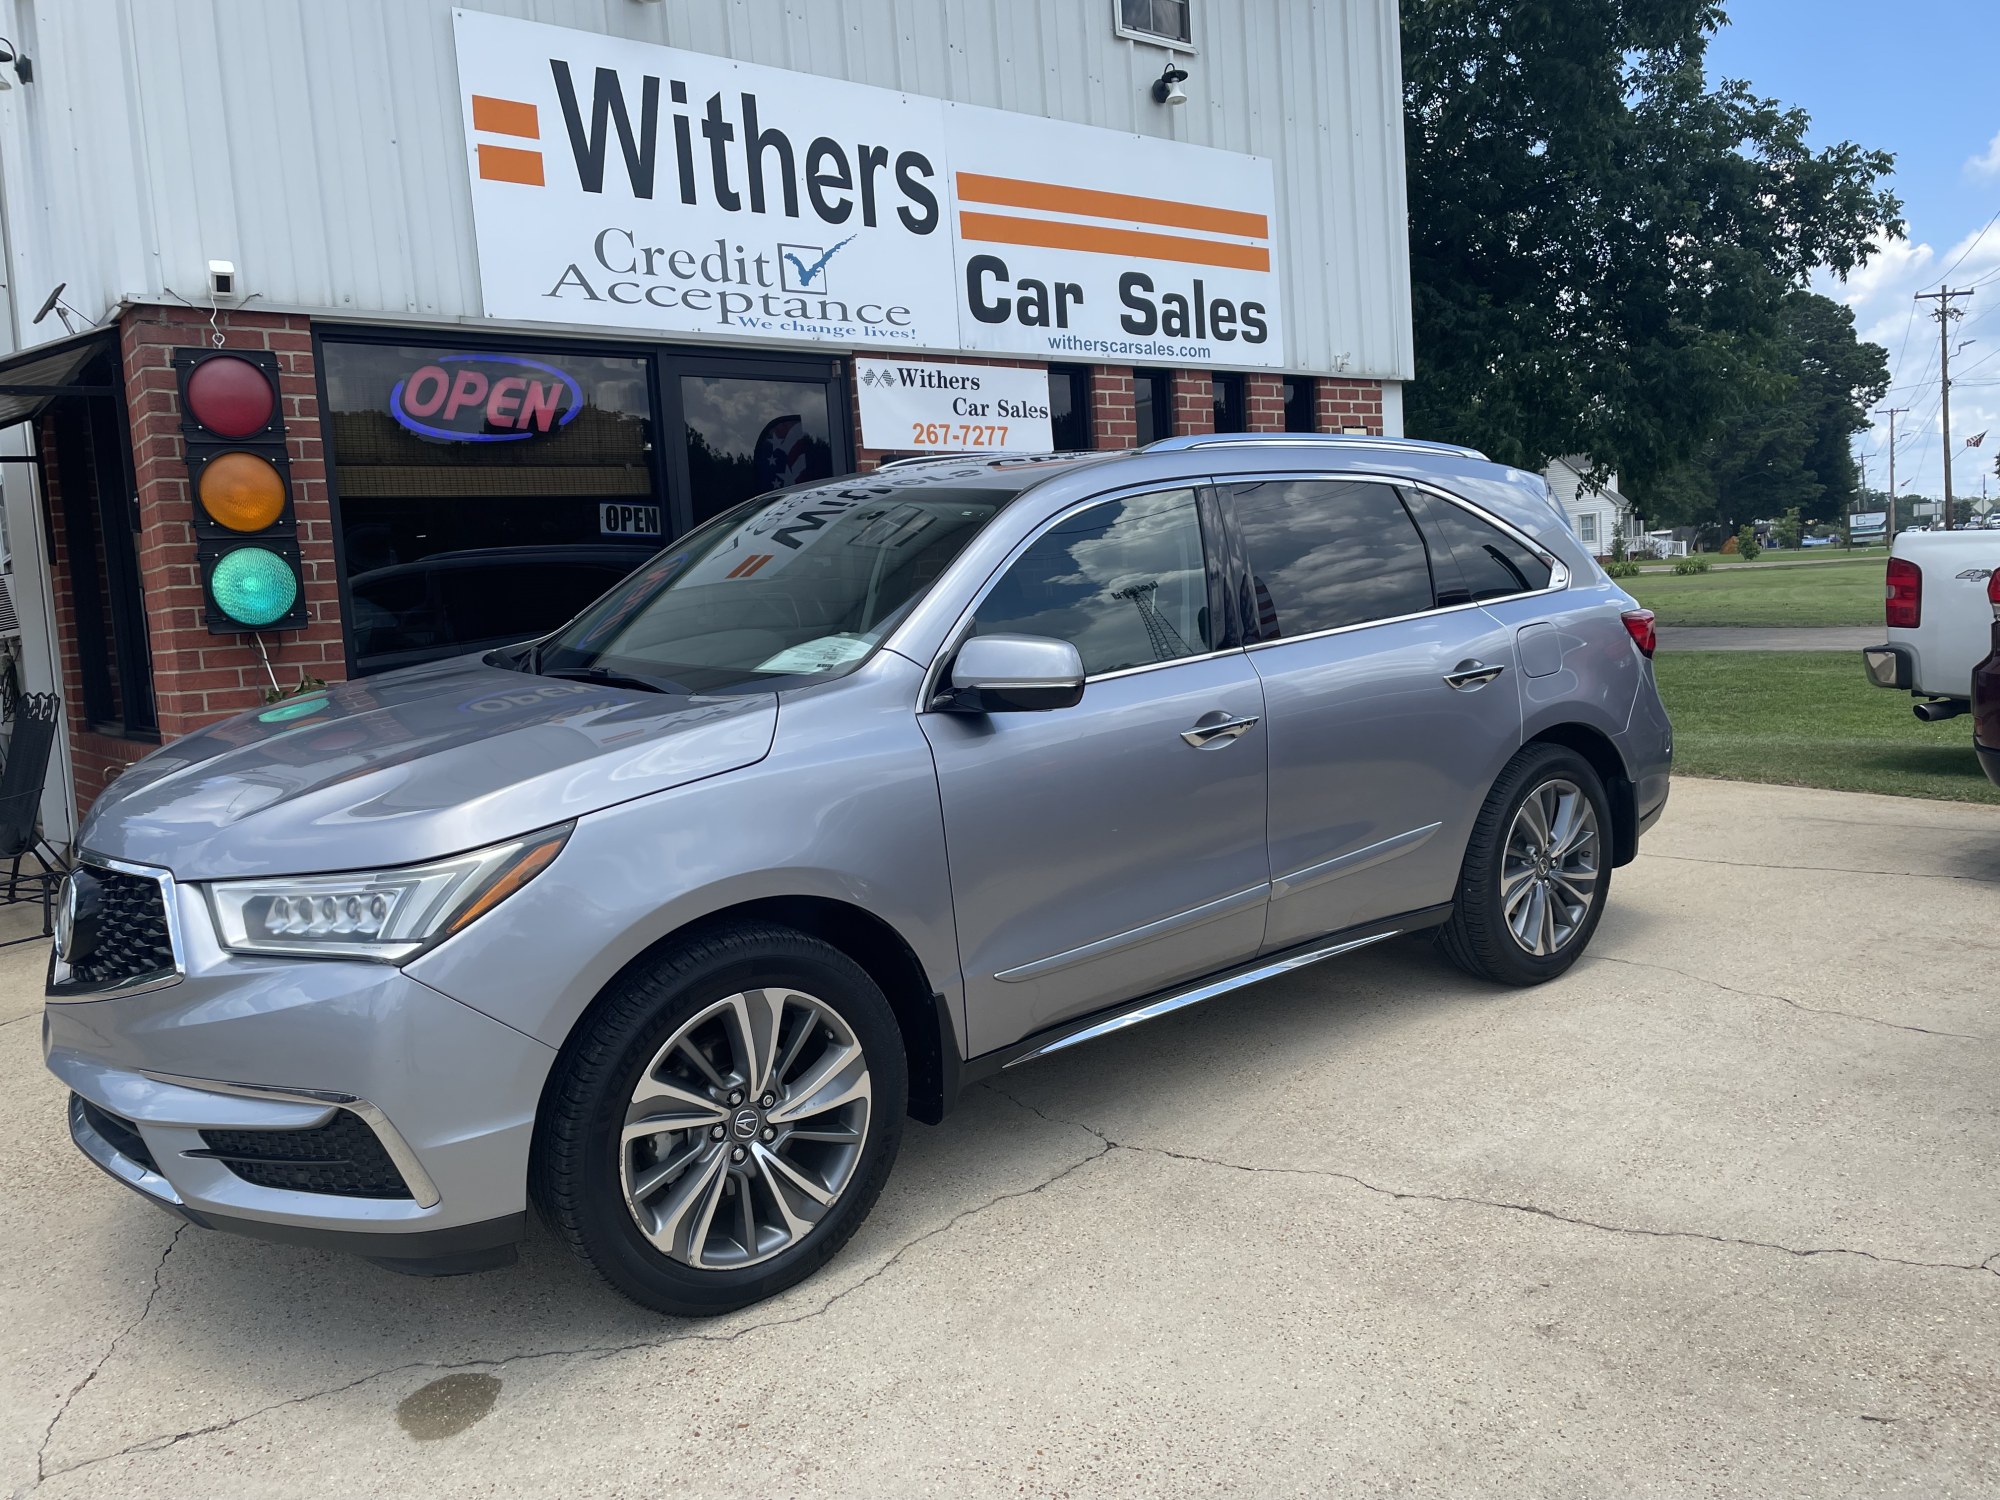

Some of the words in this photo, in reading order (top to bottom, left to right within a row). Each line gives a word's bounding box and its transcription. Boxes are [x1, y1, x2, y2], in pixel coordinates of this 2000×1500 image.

[549, 58, 940, 236] Withers
[594, 227, 774, 288] Credit
[541, 263, 912, 326] Acceptance
[966, 254, 1084, 329] Car
[1118, 271, 1269, 344] Sales
[738, 316, 773, 330] We
[780, 320, 856, 338] change
[864, 326, 916, 340] lives!
[1047, 334, 1211, 358] witherscarsales.com
[897, 367, 981, 391] Withers
[404, 365, 564, 432] OPEN
[952, 397, 989, 417] Car
[997, 399, 1049, 419] Sales
[912, 422, 1009, 447] 267-7277
[605, 505, 659, 533] OPEN
